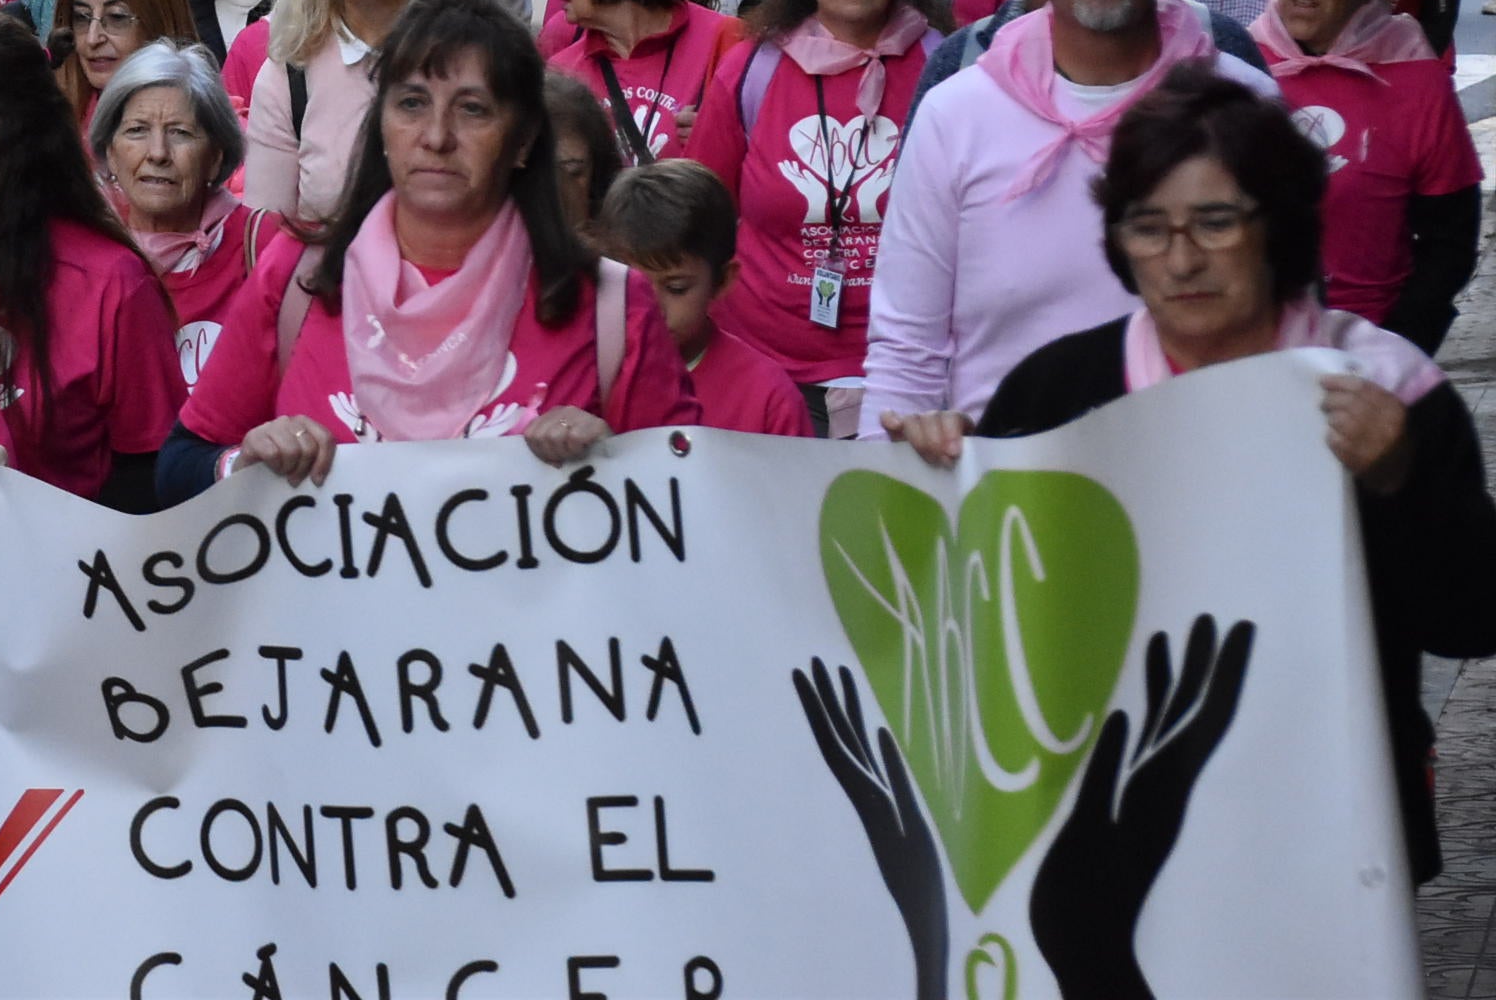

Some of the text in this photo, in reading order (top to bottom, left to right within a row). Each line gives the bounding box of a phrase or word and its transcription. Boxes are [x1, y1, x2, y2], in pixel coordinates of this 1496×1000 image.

[78, 465, 685, 632] ASOCIACIÓN
[101, 637, 701, 747] BEJARANA
[130, 795, 715, 899] CONTRA EL
